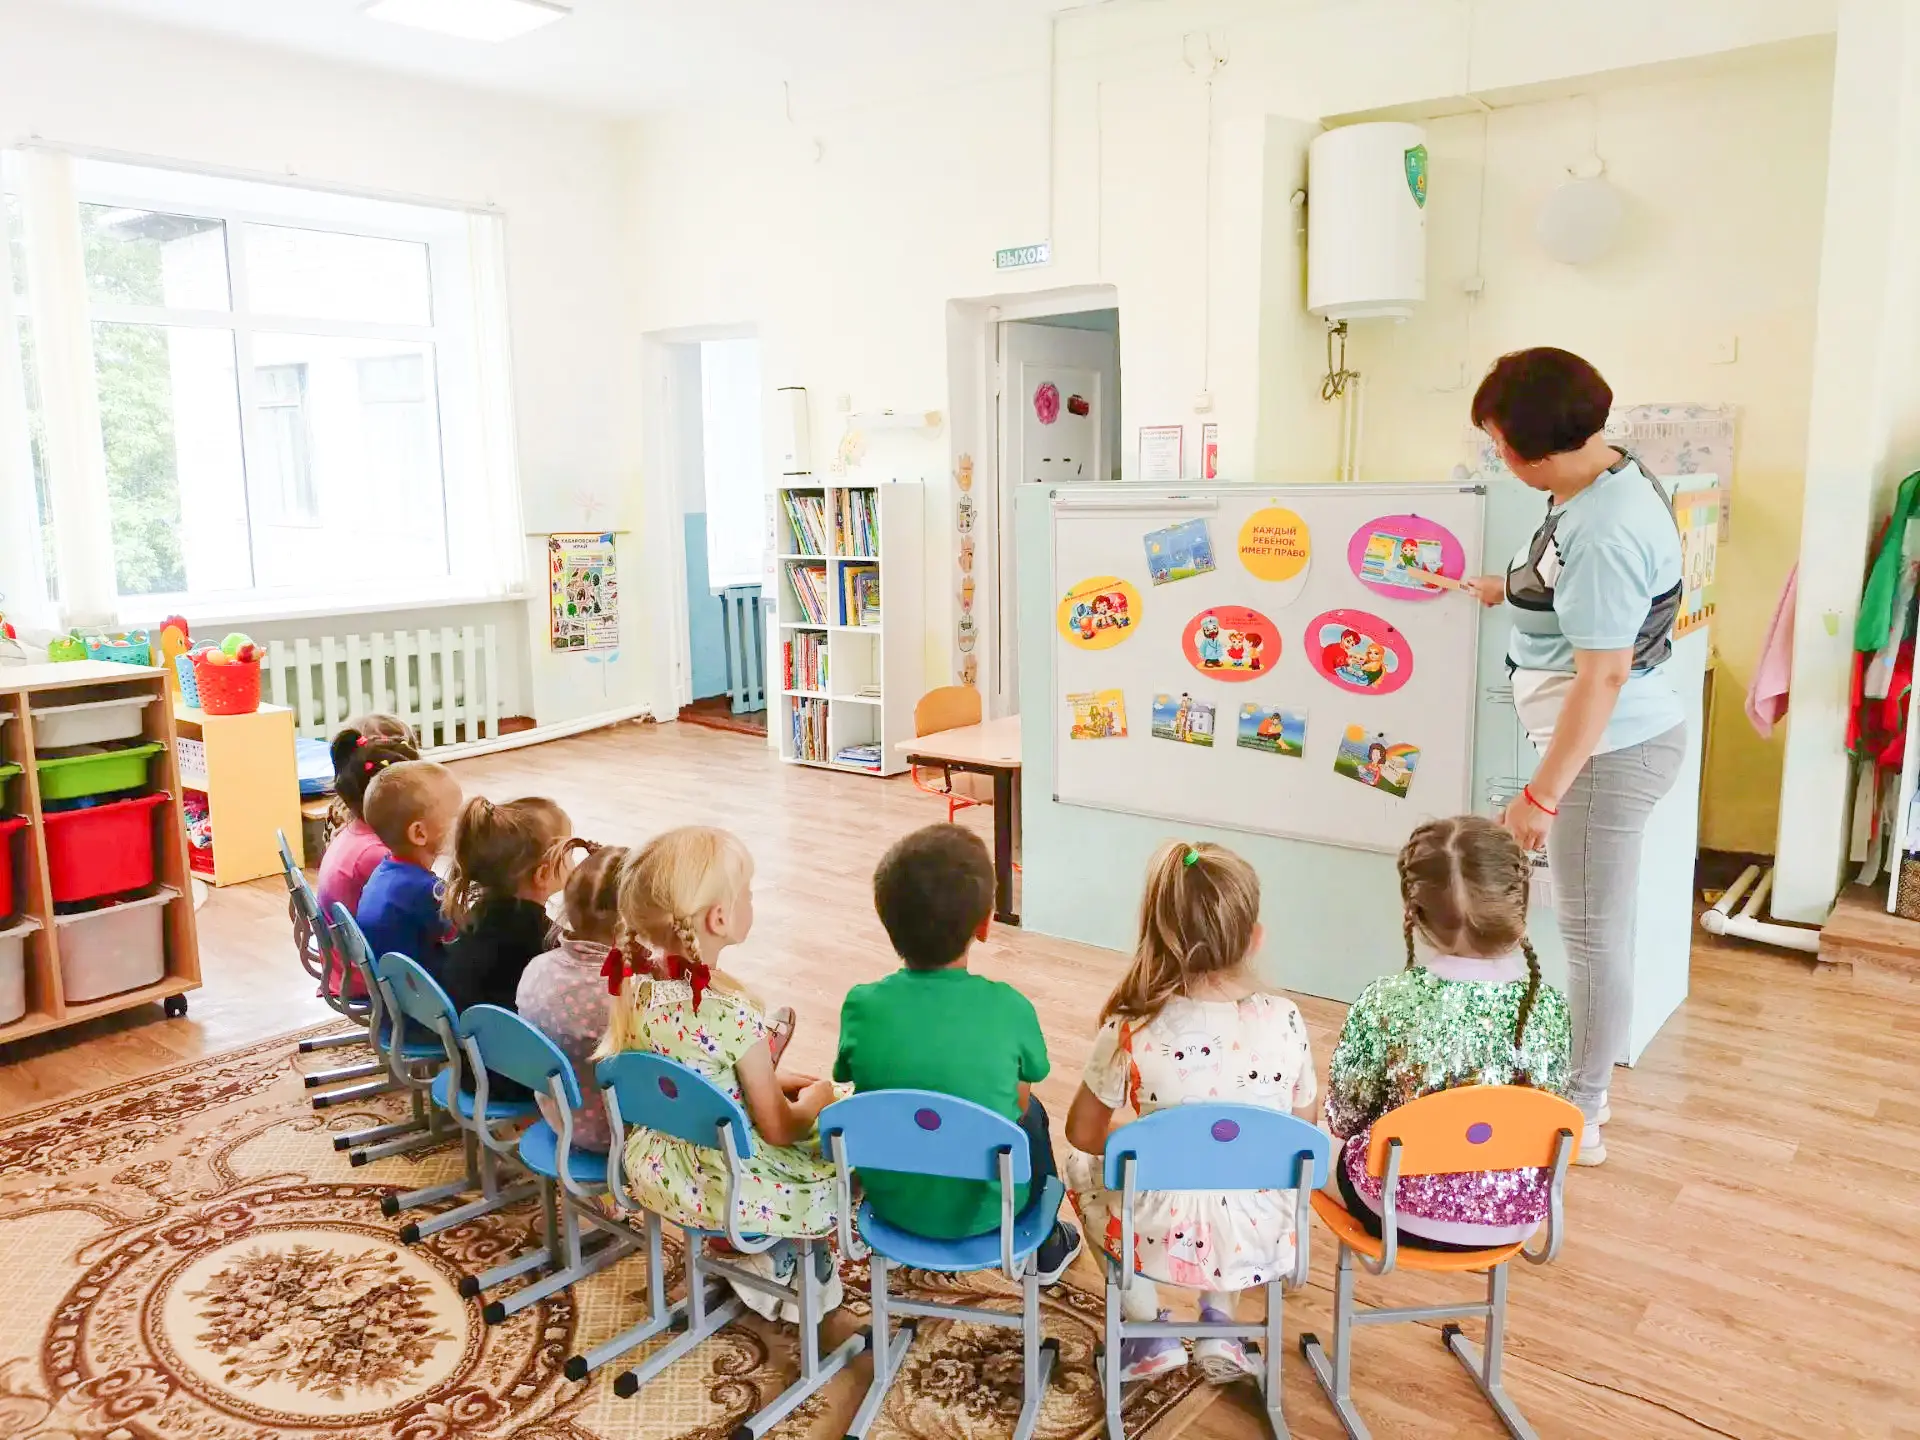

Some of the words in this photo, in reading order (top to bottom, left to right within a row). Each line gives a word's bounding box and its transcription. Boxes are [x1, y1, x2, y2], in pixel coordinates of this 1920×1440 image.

[999, 246, 1046, 266] ВЫХОД
[1253, 526, 1296, 536] КАЖДЫЙ
[1241, 545, 1272, 555] ИМЕЕТ
[1274, 548, 1305, 558] ПРАВО
